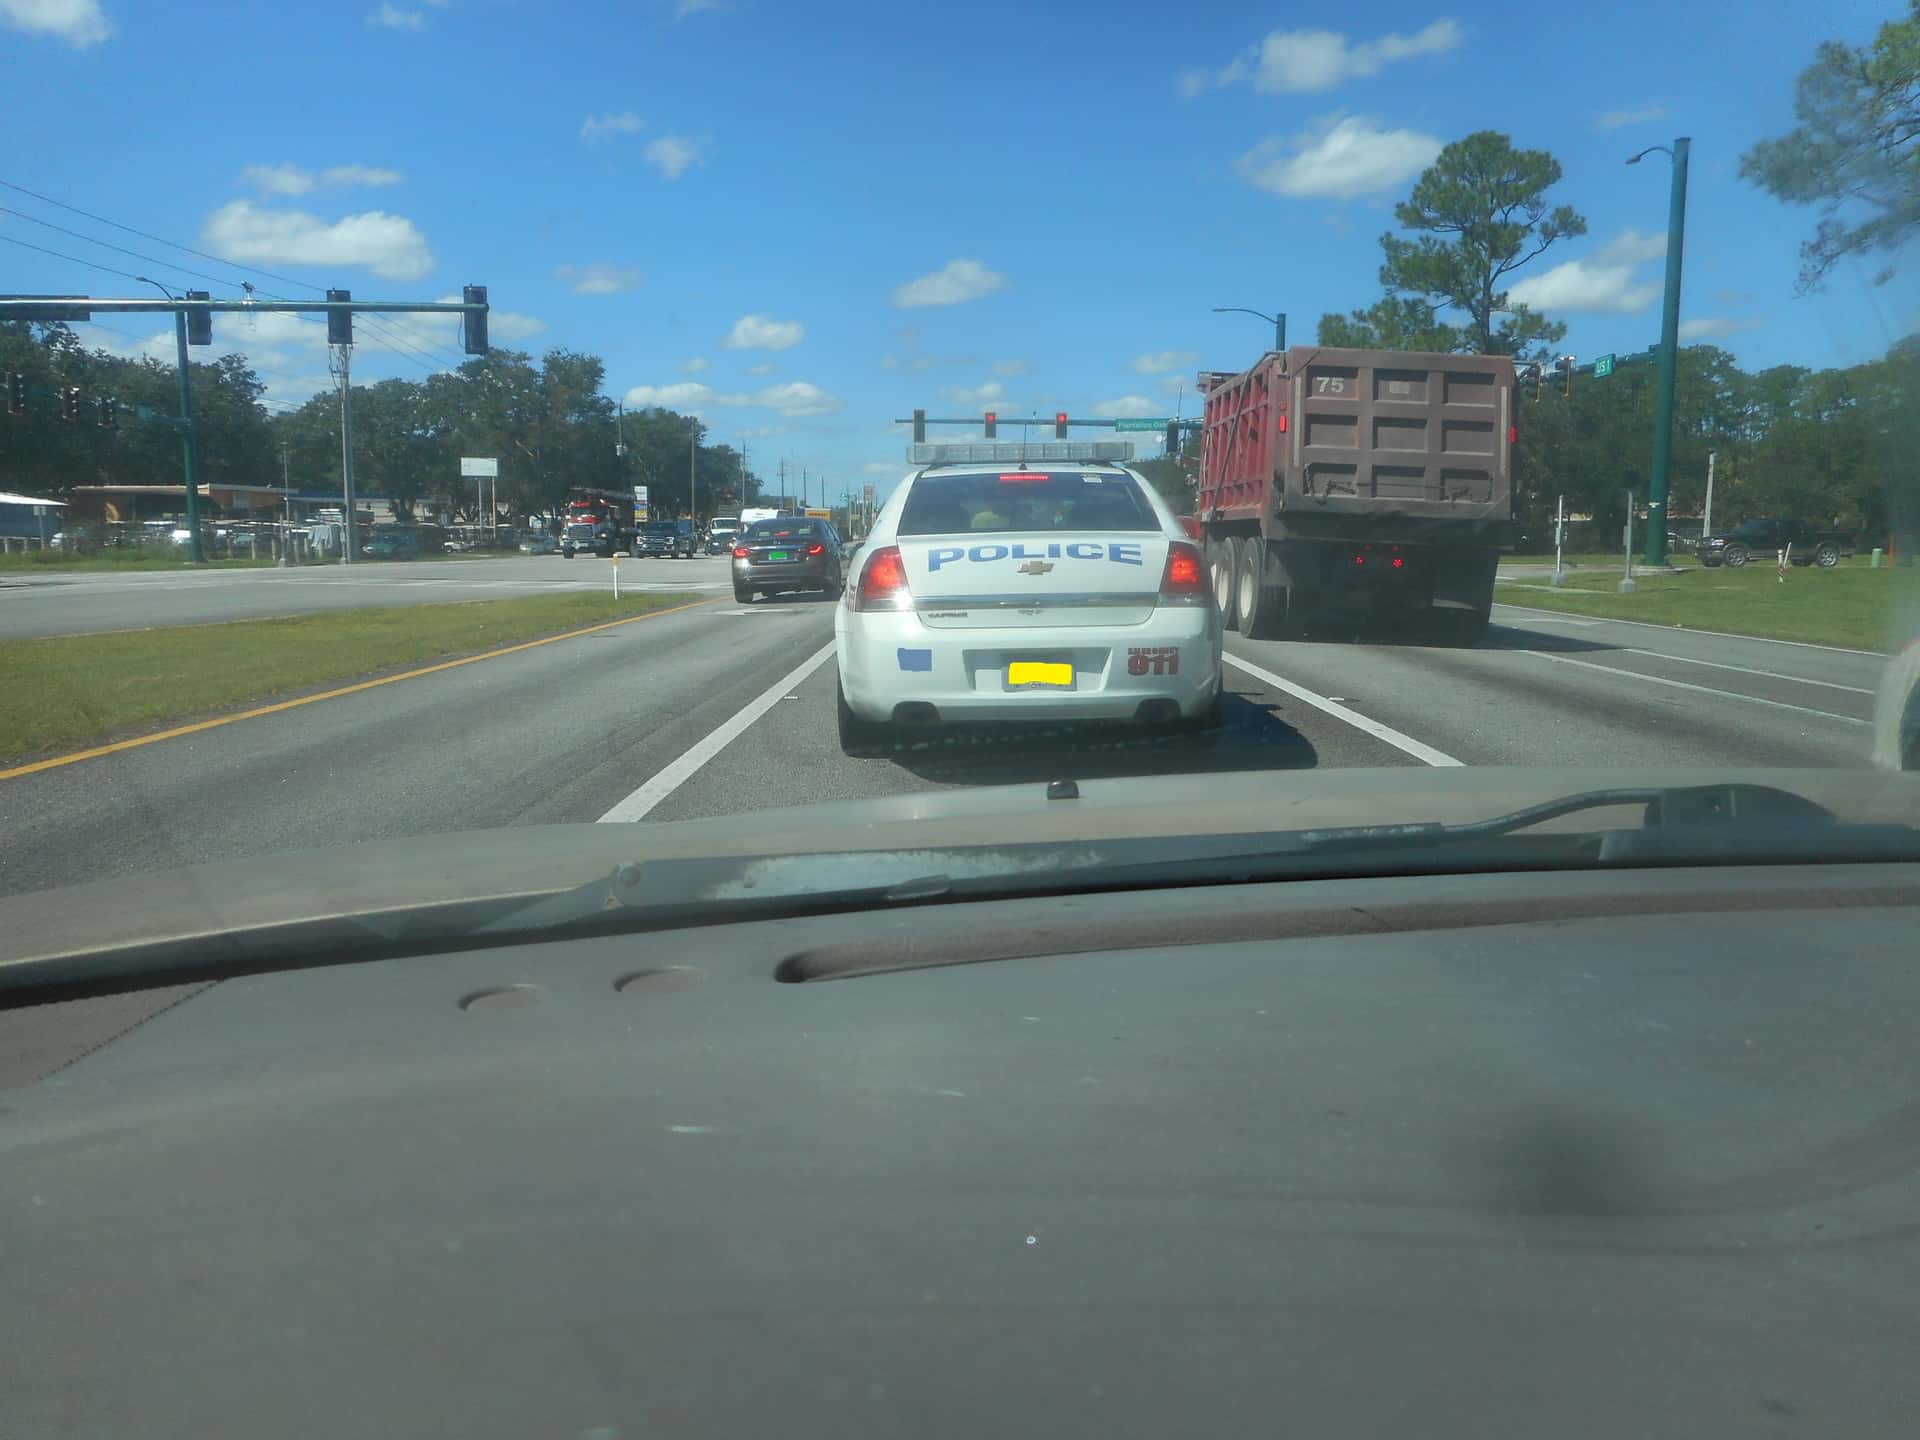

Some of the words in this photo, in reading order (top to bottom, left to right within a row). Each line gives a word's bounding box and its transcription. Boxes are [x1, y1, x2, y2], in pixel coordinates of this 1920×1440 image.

[1316, 376, 1345, 393] 75
[928, 543, 1143, 572] POLICE
[1127, 655, 1179, 676] 911
